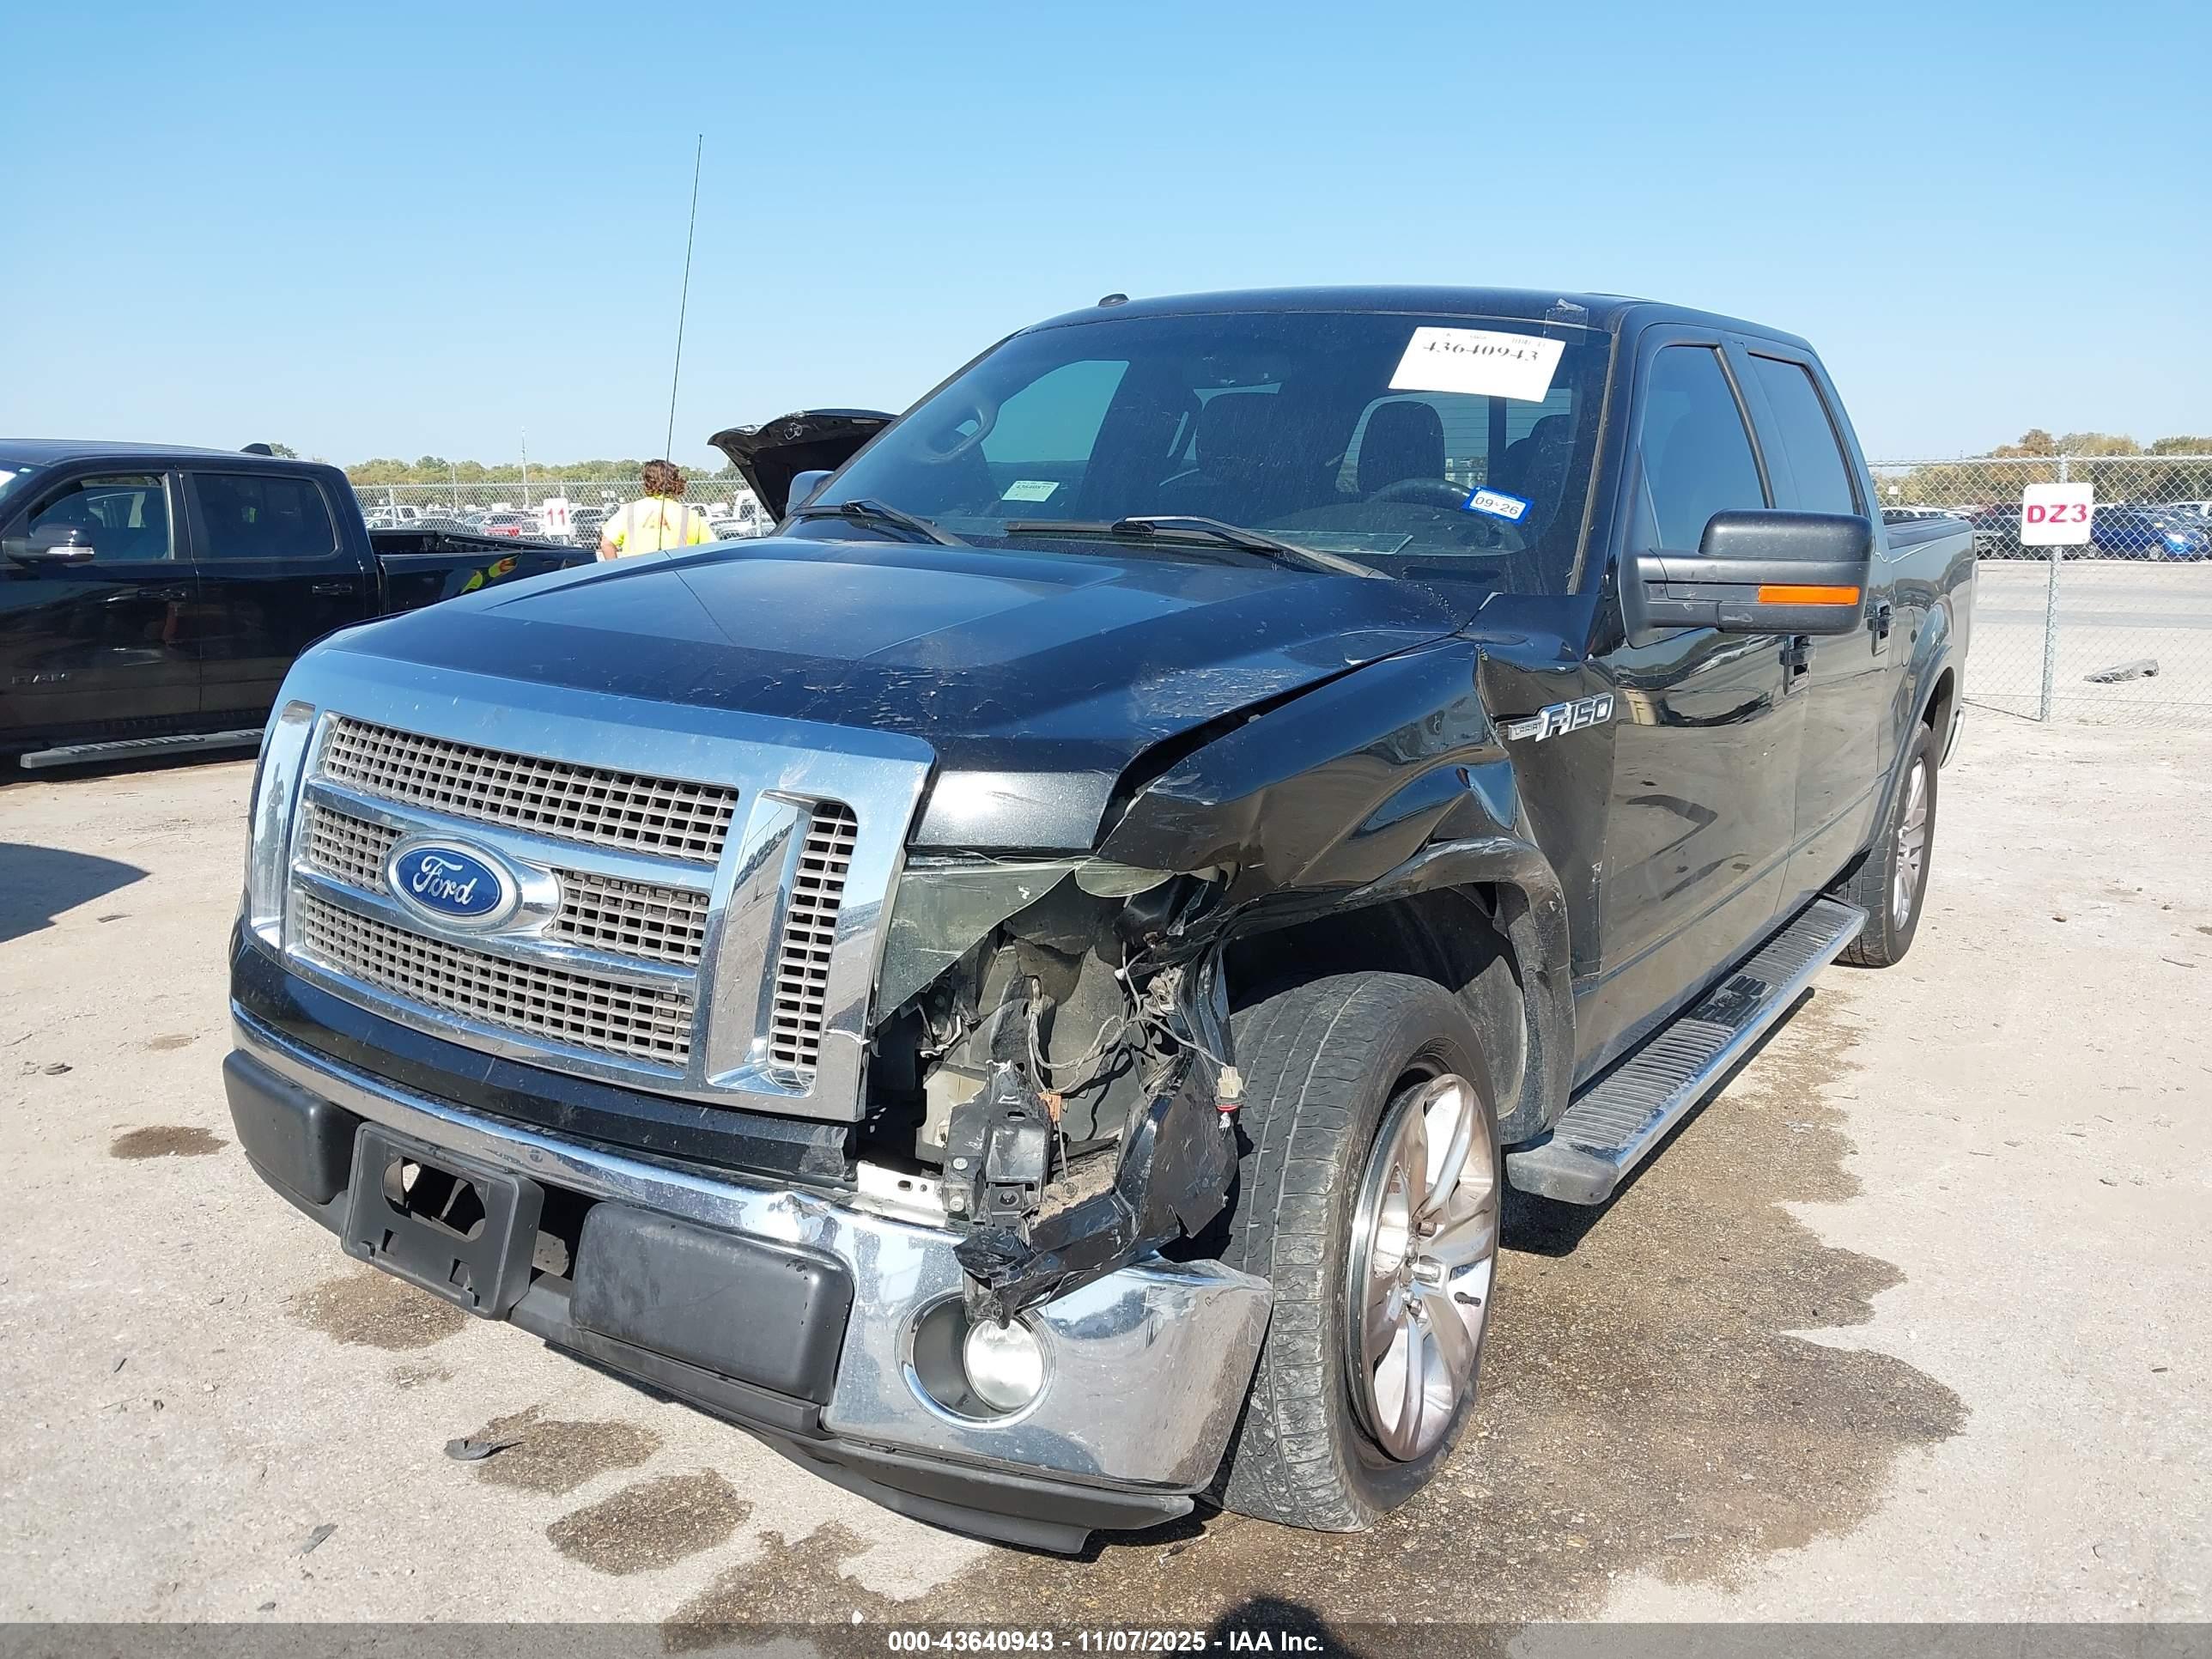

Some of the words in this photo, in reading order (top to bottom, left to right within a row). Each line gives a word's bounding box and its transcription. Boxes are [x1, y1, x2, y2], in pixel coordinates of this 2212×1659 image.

[1423, 342, 1538, 362] 43640943
[546, 507, 566, 526] 11
[2027, 503, 2087, 523] DZ3
[412, 855, 478, 905] Ford
